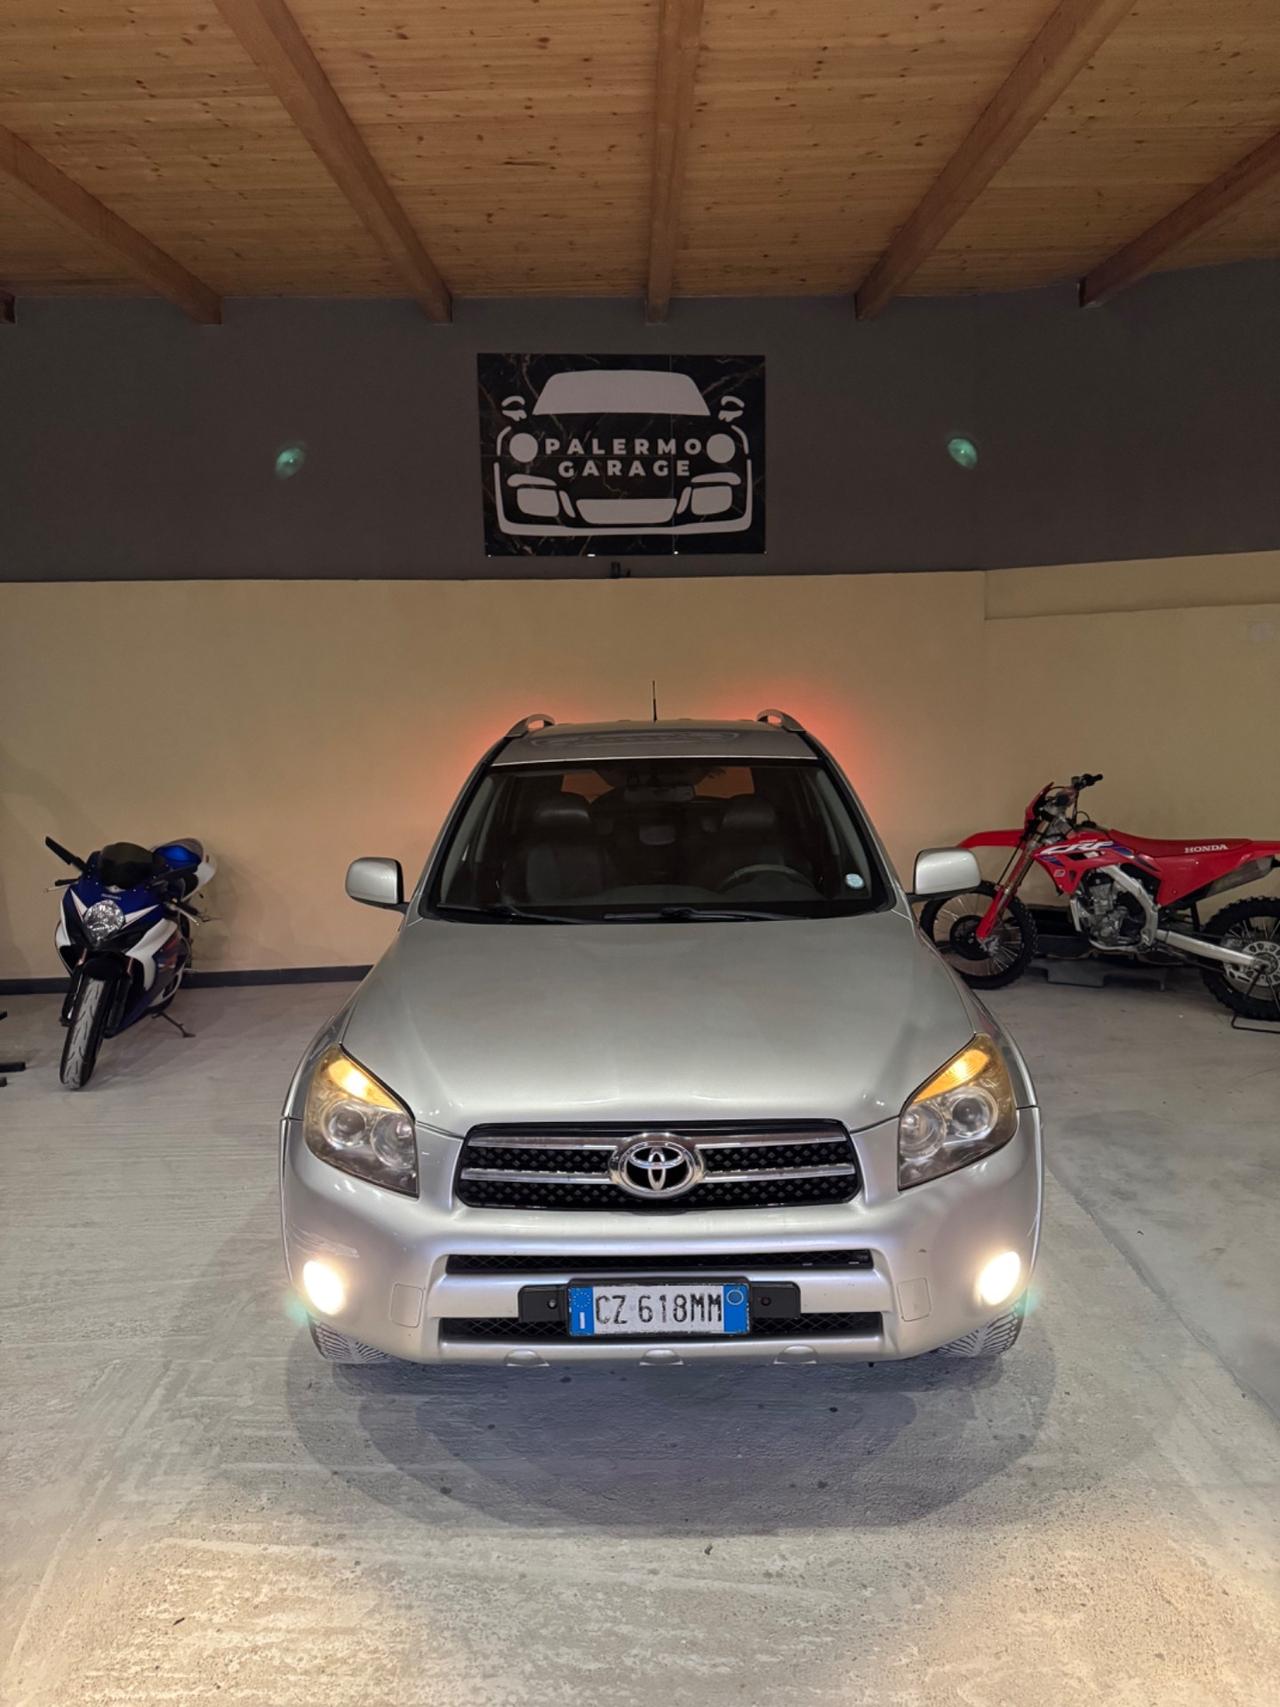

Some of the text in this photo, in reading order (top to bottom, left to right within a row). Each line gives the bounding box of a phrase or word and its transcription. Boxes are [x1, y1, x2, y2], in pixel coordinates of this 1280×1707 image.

[545, 438, 702, 455] PALERMO
[558, 459, 690, 478] GARAGE
[1184, 843, 1229, 854] HONDA
[595, 1294, 628, 1325] CZ
[637, 1292, 722, 1324] 618MM
